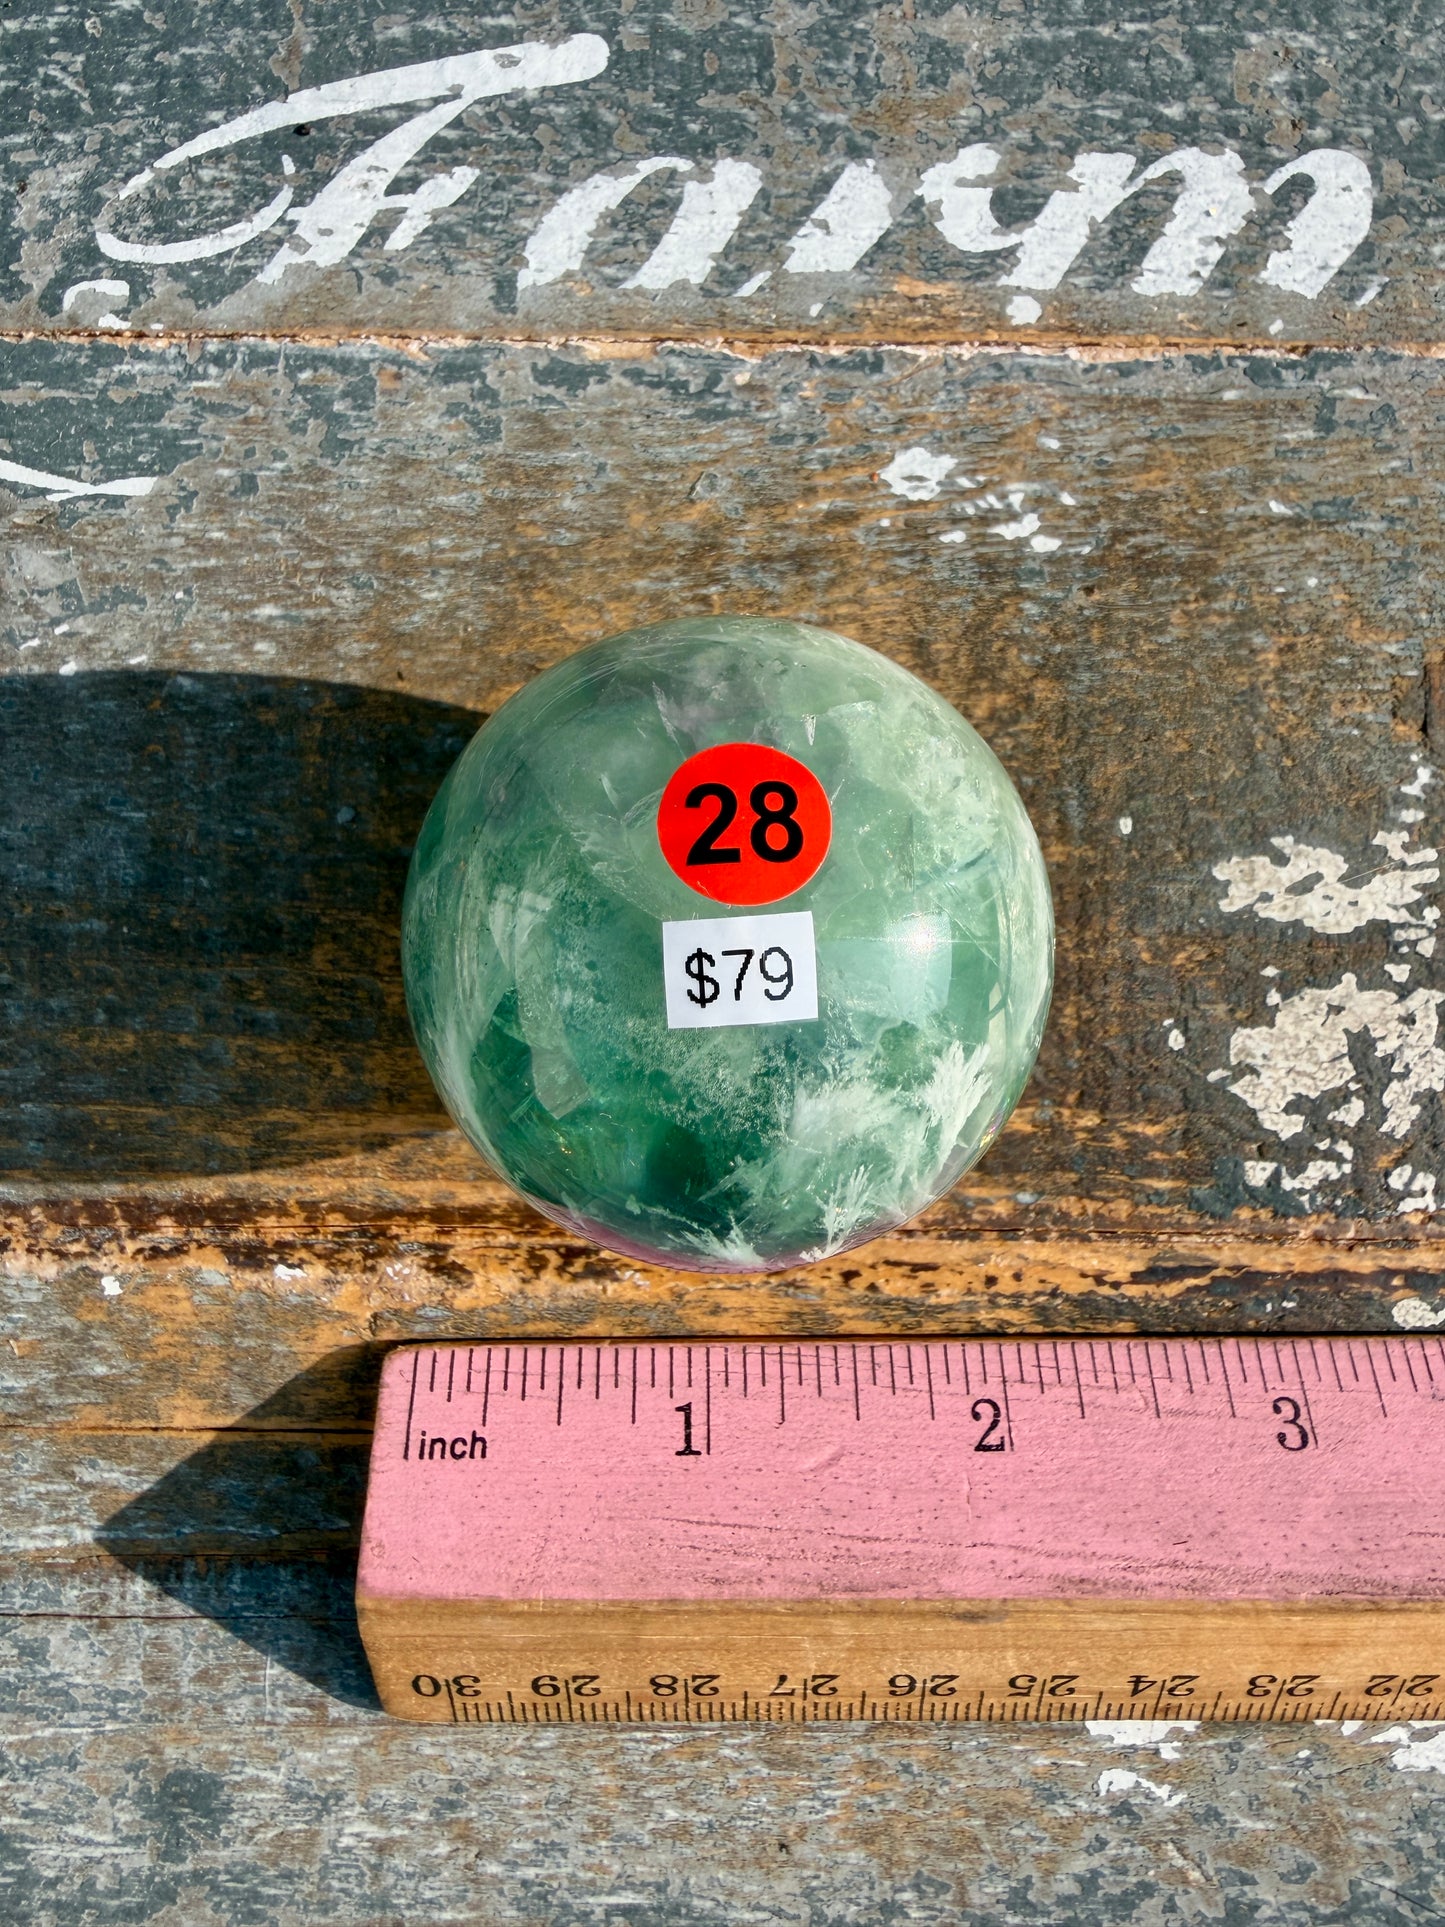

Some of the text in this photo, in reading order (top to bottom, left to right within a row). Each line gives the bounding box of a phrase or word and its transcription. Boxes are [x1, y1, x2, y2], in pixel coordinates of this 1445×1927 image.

[684, 780, 804, 867] 28
[685, 946, 795, 1009] $79
[418, 1396, 1310, 1460] inch 1 2 3
